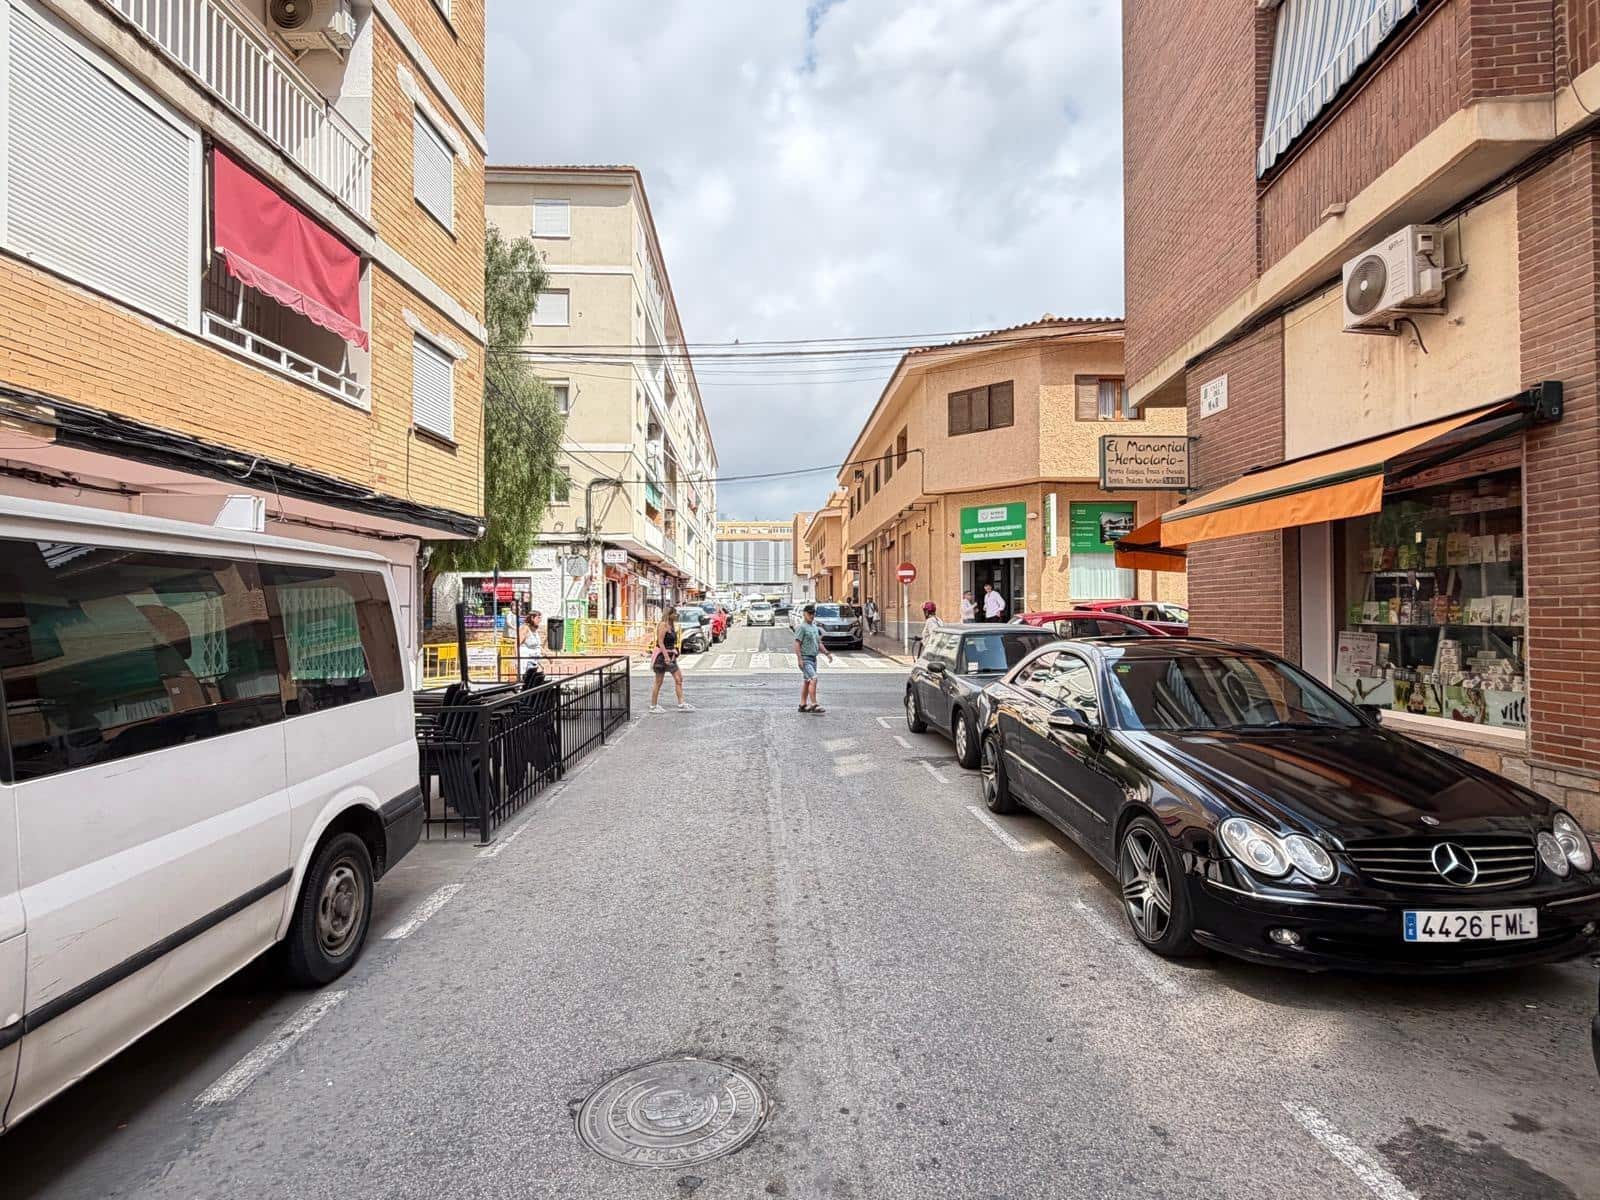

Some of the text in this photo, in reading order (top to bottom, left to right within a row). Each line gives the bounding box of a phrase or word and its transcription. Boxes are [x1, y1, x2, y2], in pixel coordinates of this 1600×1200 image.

[1106, 440, 1186, 452] El Manantial
[1421, 915, 1483, 938] 4426
[1491, 913, 1531, 937] FML
